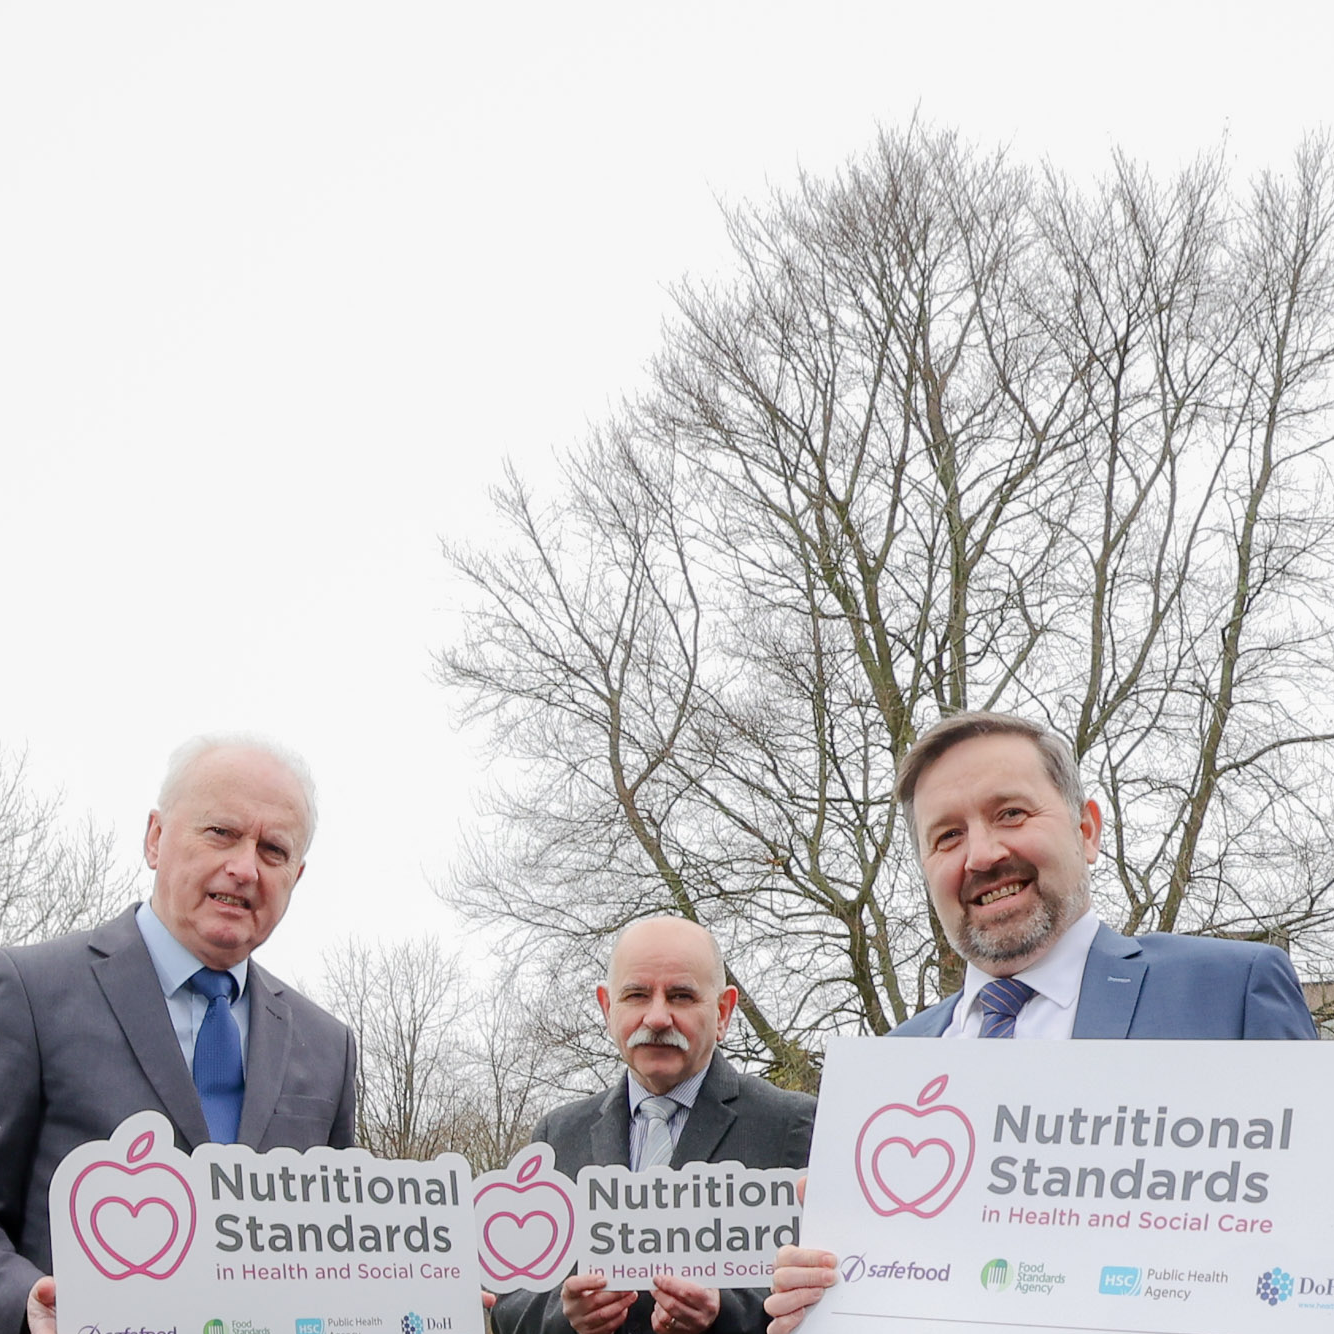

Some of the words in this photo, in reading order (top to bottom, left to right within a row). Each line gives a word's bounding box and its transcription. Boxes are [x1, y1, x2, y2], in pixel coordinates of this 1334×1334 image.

[993, 1104, 1293, 1149] Nutritional
[210, 1163, 459, 1205] Nutritional
[987, 1155, 1269, 1203] Standards
[589, 1174, 794, 1210] Nutrition
[981, 1205, 1000, 1223] in
[1008, 1207, 1080, 1226] Health
[1088, 1211, 1131, 1228] and
[1138, 1211, 1208, 1231] Social
[1218, 1214, 1273, 1234] Care
[215, 1214, 451, 1252] Standards
[590, 1216, 799, 1255] Standard
[217, 1264, 234, 1280] in
[243, 1264, 307, 1280] Health
[316, 1263, 350, 1279] and
[358, 1263, 413, 1279] Social
[420, 1264, 460, 1278] Care
[589, 1265, 604, 1277] in
[612, 1263, 674, 1279] Health
[681, 1262, 716, 1277] and
[724, 1261, 774, 1276] Socia
[867, 1261, 951, 1282] safefood
[1019, 1262, 1044, 1273] Food
[1147, 1268, 1185, 1282] Public
[1187, 1270, 1229, 1283] Health
[1017, 1272, 1065, 1284] Standards
[1105, 1274, 1133, 1287] HSC
[1015, 1282, 1053, 1295] Agency
[1144, 1287, 1191, 1301] Agency
[232, 1320, 252, 1328] Food
[299, 1324, 319, 1334] HSC
[328, 1318, 353, 1327] Public
[356, 1317, 382, 1326] Health
[427, 1317, 452, 1330] DoH
